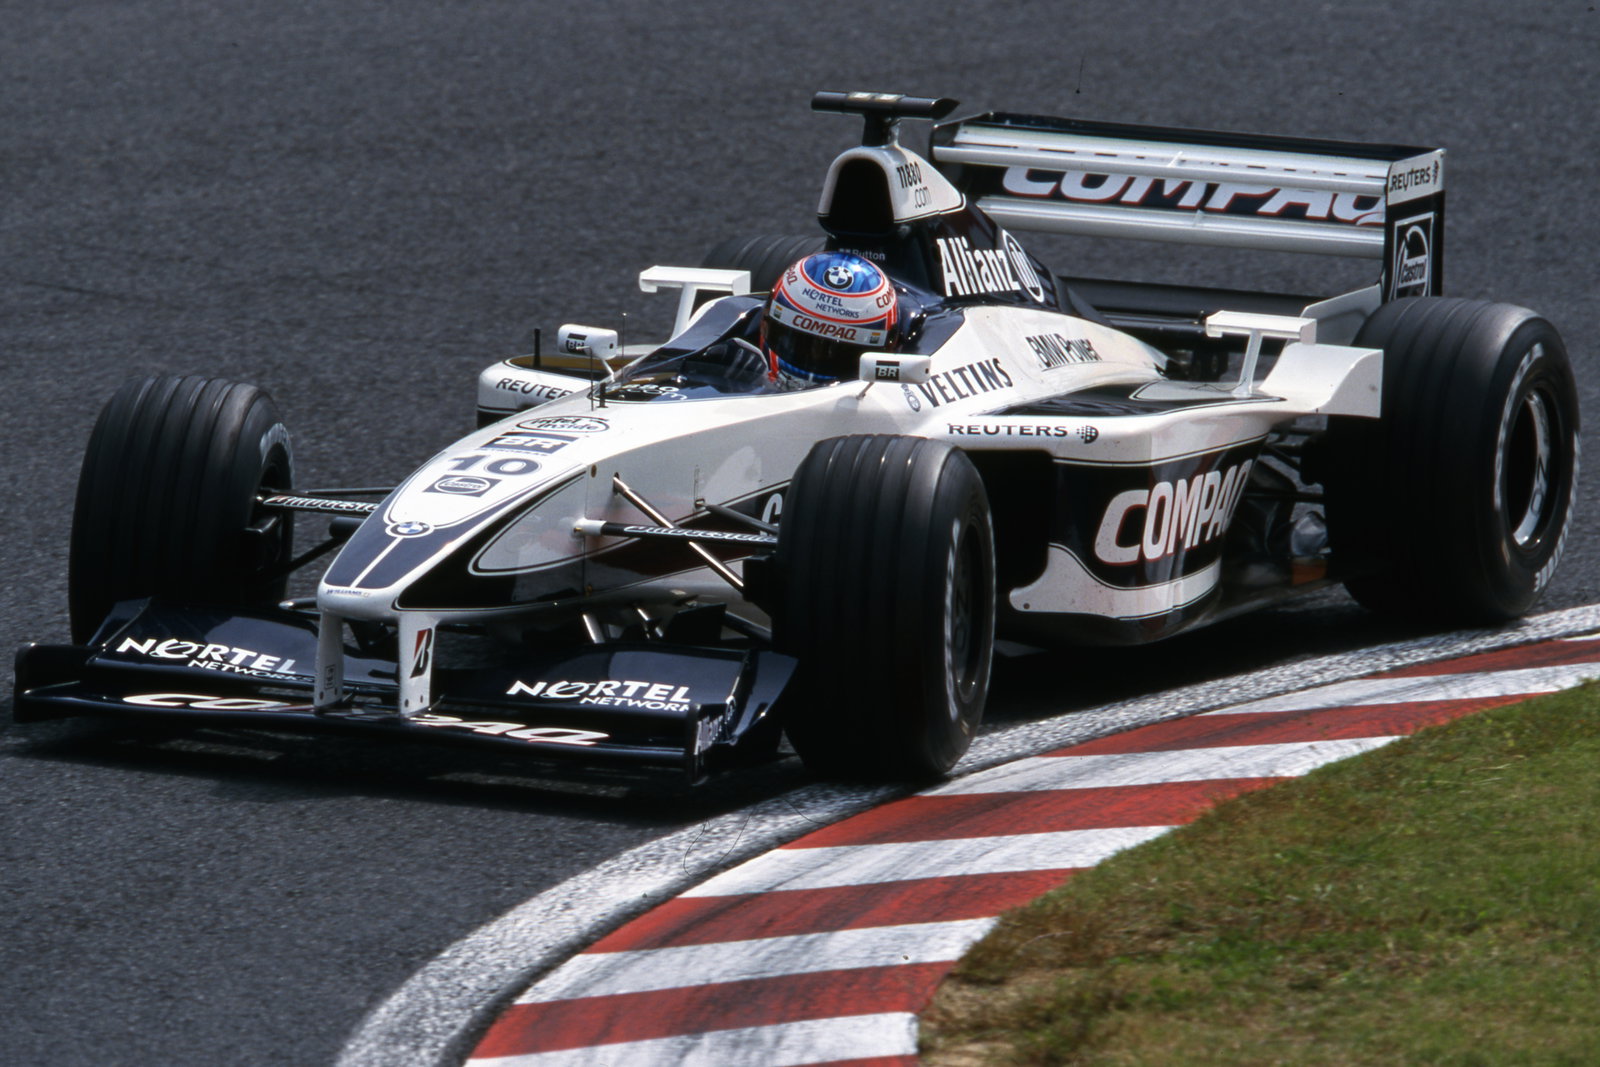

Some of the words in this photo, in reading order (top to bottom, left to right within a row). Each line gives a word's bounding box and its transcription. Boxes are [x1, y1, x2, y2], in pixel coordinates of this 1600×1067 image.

[1391, 166, 1431, 192] REUTERS
[936, 236, 1021, 297] Allianz
[801, 288, 843, 308] NORTEL
[815, 302, 860, 319] NETWORKS
[792, 315, 857, 341] COMPAQ
[1025, 333, 1070, 368] BMW
[877, 367, 898, 378] BR
[916, 357, 1014, 408] VELTINS
[496, 377, 573, 400] REUTER
[947, 424, 1069, 437] REUTERS
[447, 455, 542, 476] 10
[1095, 458, 1253, 566] COMPAQ
[116, 637, 298, 675] NORTEL
[506, 680, 691, 703] NORTEL
